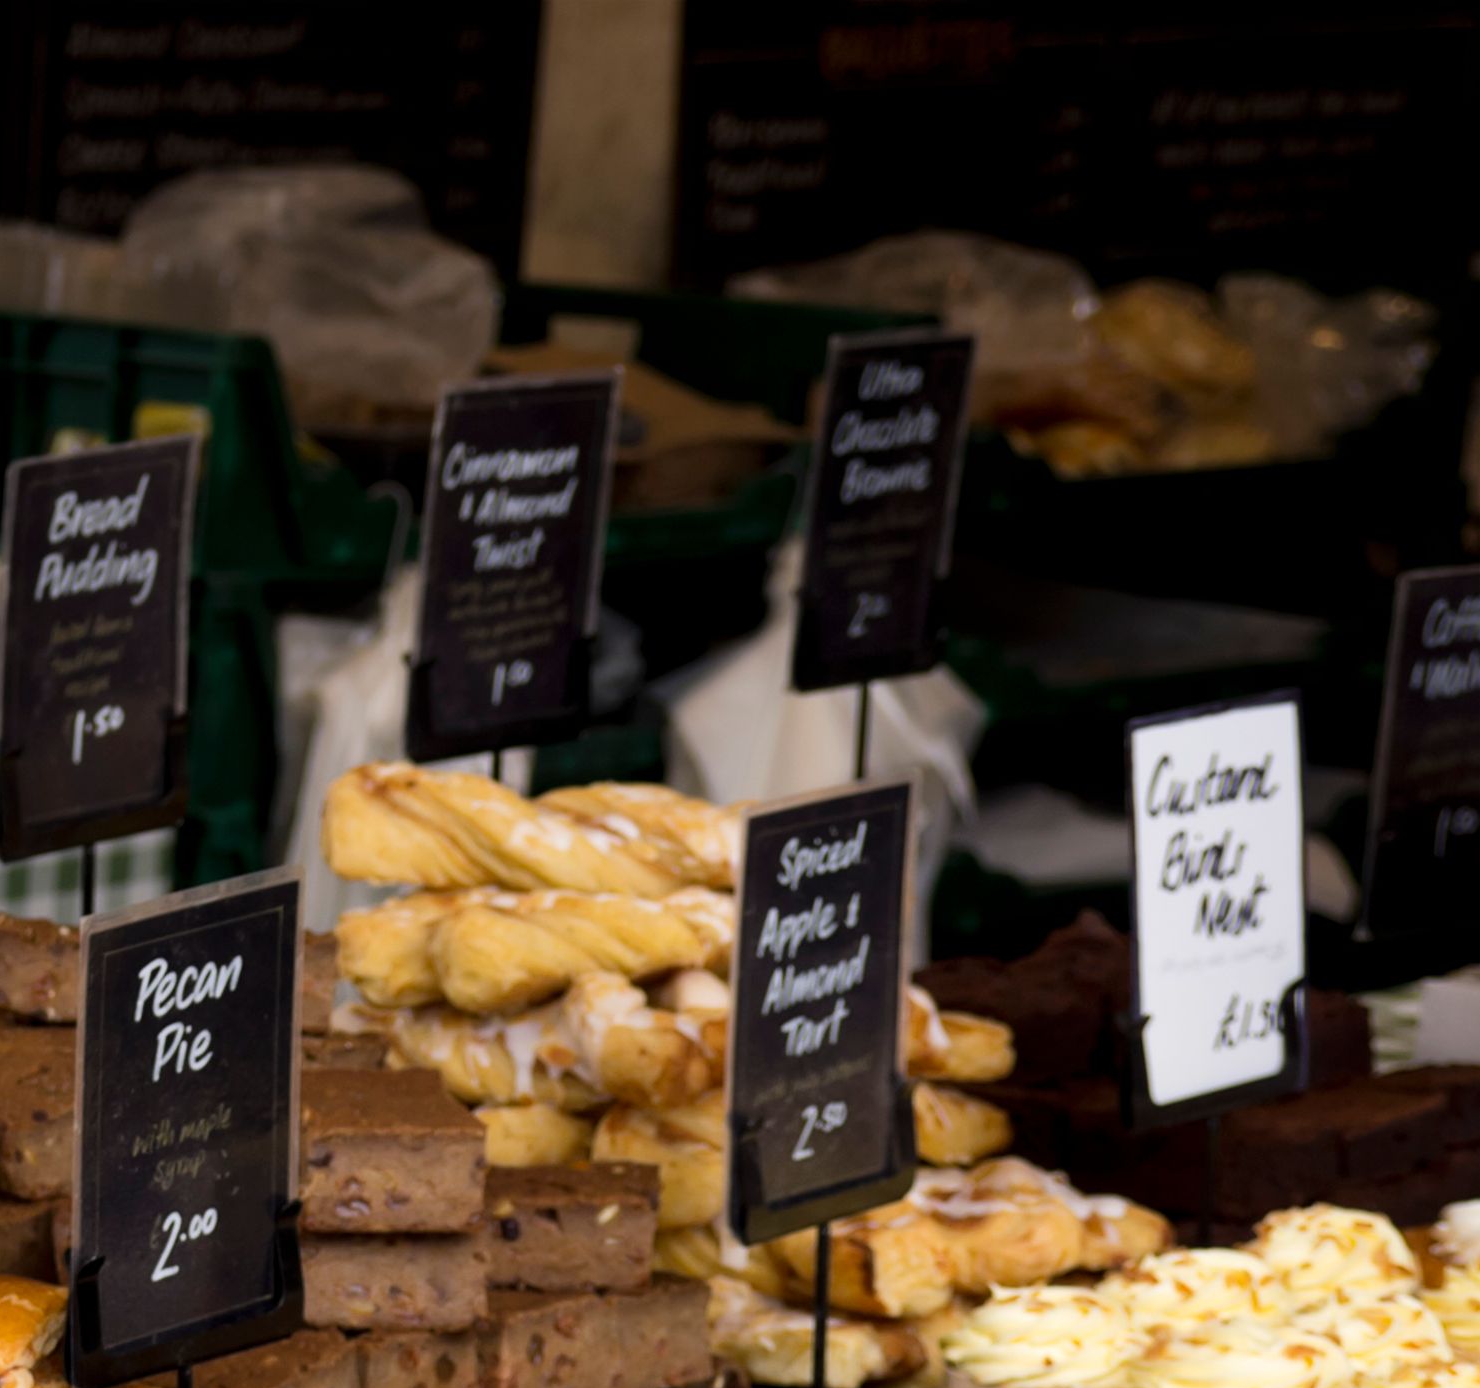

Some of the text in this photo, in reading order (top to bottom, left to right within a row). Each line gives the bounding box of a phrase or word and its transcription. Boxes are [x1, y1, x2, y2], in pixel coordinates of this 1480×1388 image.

[441, 442, 579, 490] Cinnamon
[48, 473, 150, 543] Bread
[475, 479, 578, 527] Almond
[35, 542, 158, 605] Pudding
[473, 528, 546, 572] Twist
[1146, 752, 1279, 817] Custard
[776, 819, 868, 891] Spiced
[756, 897, 838, 962] Apple
[1193, 873, 1270, 938] Nest
[134, 954, 243, 1023] Pecan
[761, 935, 871, 1016] Almond
[152, 1020, 214, 1082] Pie
[781, 998, 849, 1057] Tart
[132, 1103, 233, 1159] with maple
[152, 1151, 207, 1192] syrup
